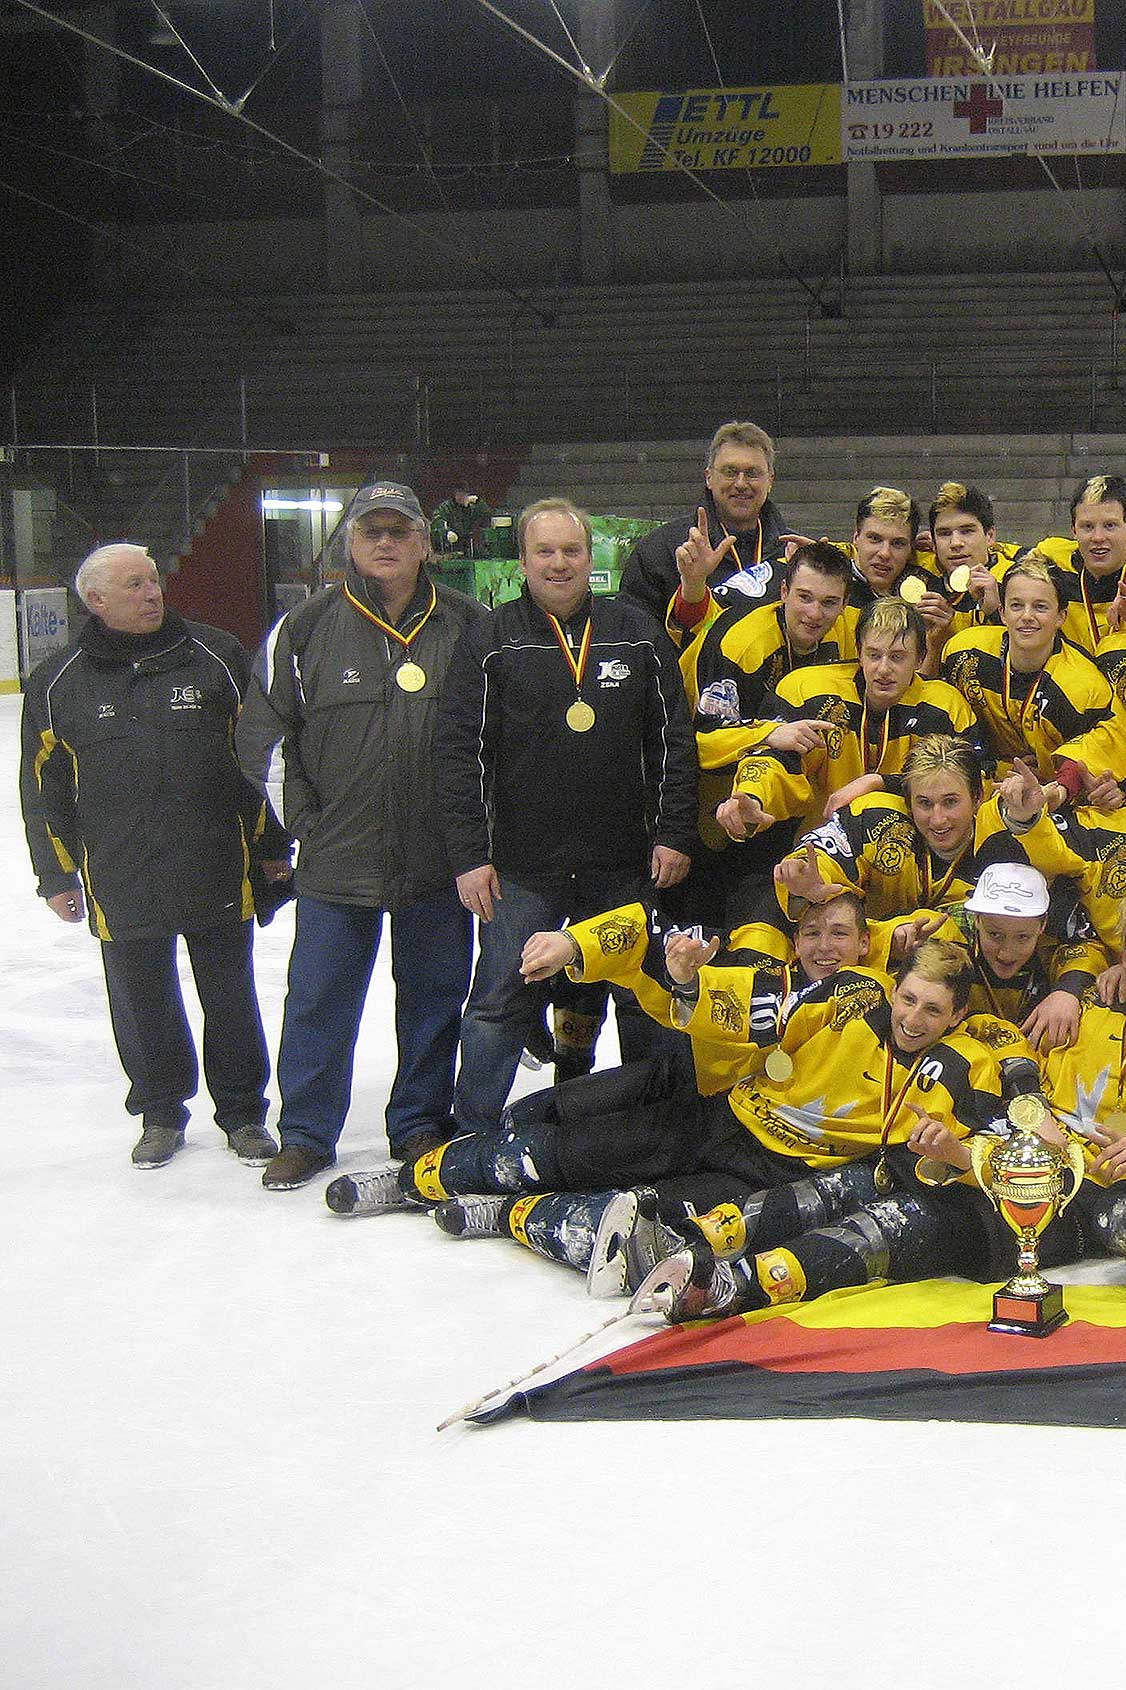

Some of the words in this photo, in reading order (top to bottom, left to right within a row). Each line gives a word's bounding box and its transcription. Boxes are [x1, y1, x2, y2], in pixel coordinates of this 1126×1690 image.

[933, 51, 1089, 76] IRSNGEN
[848, 86, 968, 104] MENSCHEN
[1034, 80, 1119, 99] HELFEN
[682, 92, 779, 123] ETTL
[677, 128, 766, 145] Umzüge
[873, 123, 894, 139] 19
[899, 122, 934, 138] 222
[713, 147, 739, 165] KF
[749, 145, 811, 164] 12000
